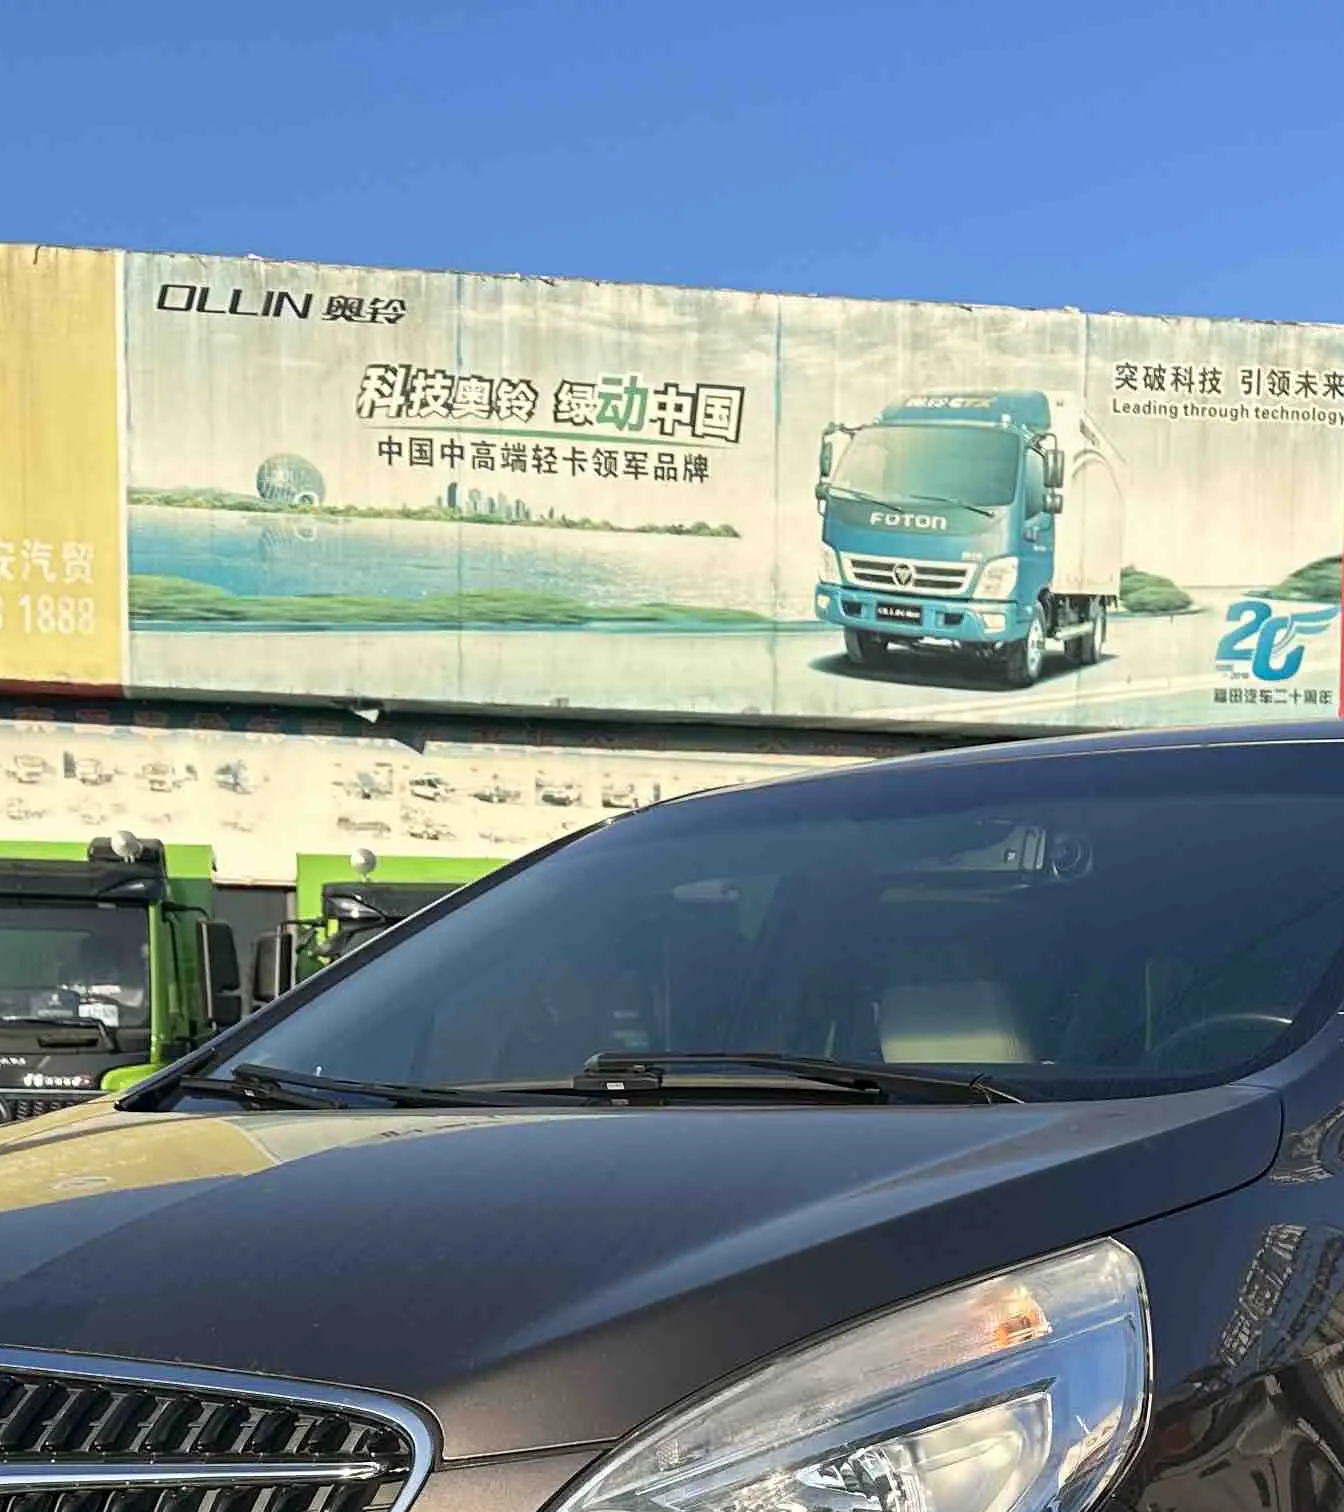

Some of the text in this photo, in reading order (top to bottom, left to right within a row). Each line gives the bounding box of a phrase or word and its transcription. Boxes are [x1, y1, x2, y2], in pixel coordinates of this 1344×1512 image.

[156, 283, 407, 325] OLLIN 奥铃
[1114, 362, 1223, 395] 突破科技
[357, 364, 745, 443] 科技奥铃 绿动中国
[1112, 398, 1179, 420] Leading
[1183, 403, 1249, 422] through
[377, 435, 710, 484] 中国中高端轻卡领军品牌
[869, 511, 948, 531] FOTON
[18, 594, 97, 635] 1888
